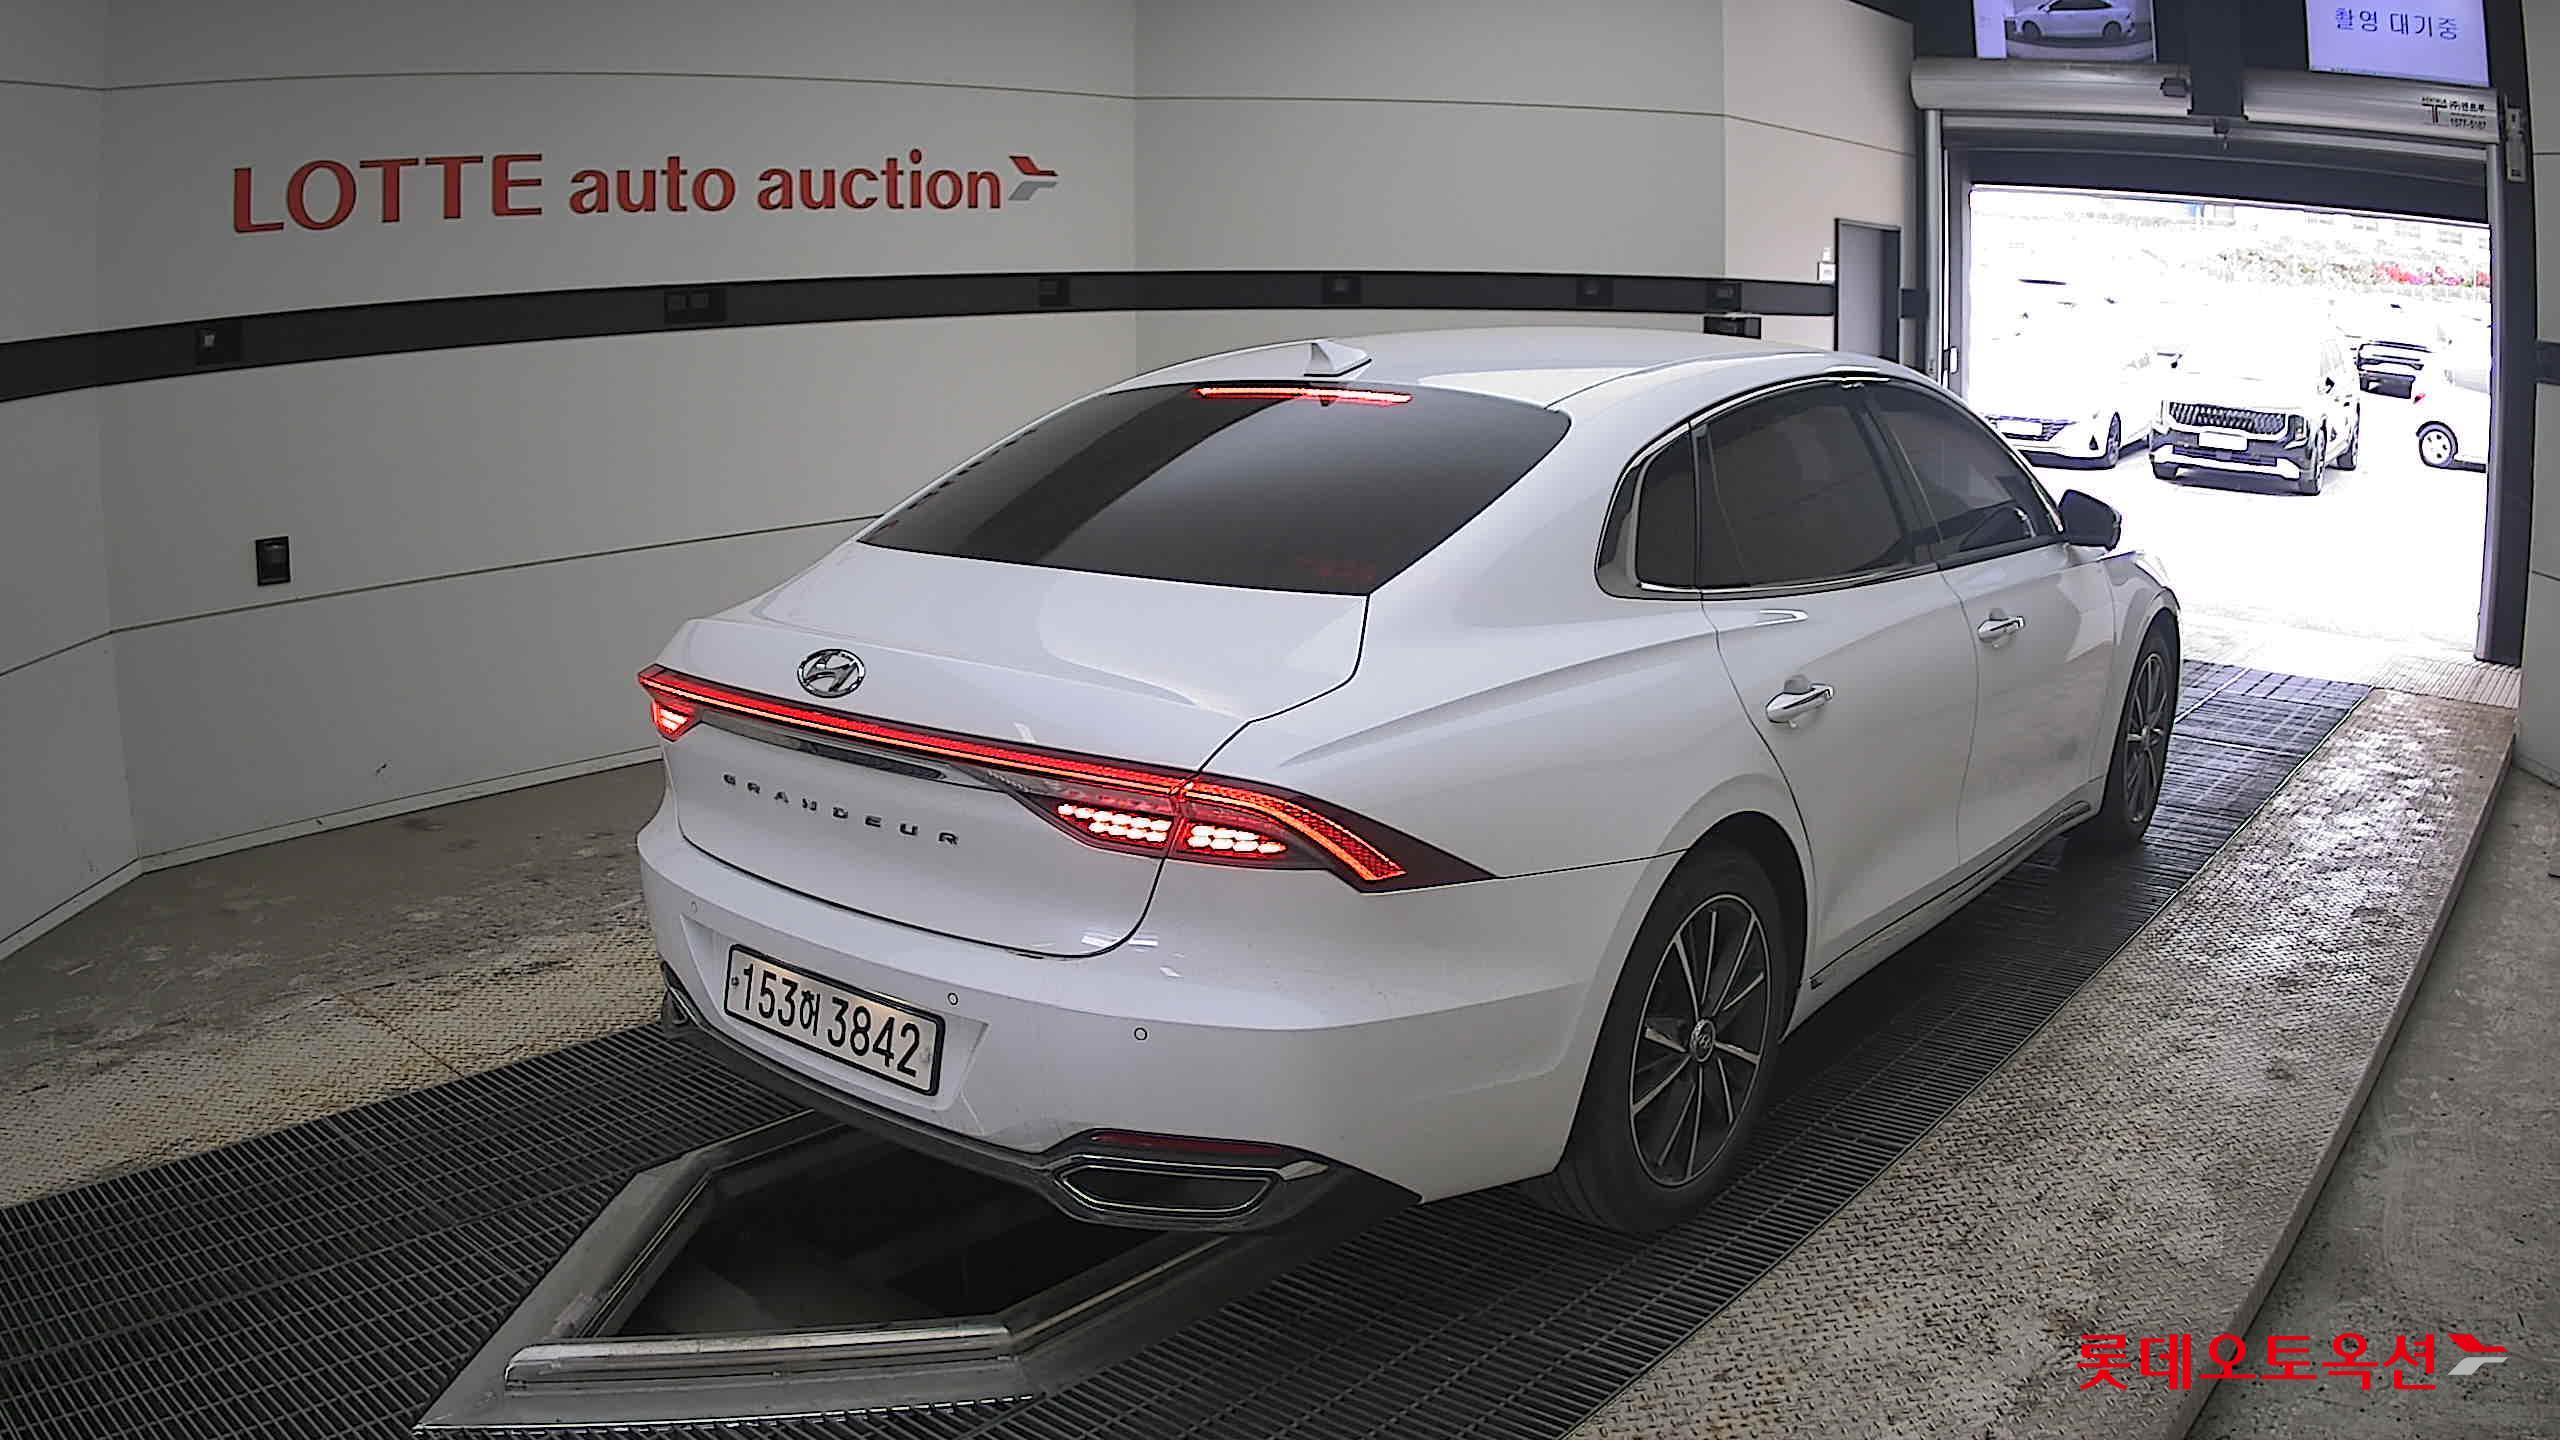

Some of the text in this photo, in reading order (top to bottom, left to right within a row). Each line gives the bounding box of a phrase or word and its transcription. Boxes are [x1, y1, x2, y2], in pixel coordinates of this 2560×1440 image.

[2390, 12, 2458, 41] 대기중
[234, 149, 1004, 233] LOTTE auto auction
[723, 774, 959, 845] GRANDEUR
[743, 963, 921, 1077] 153허 3842
